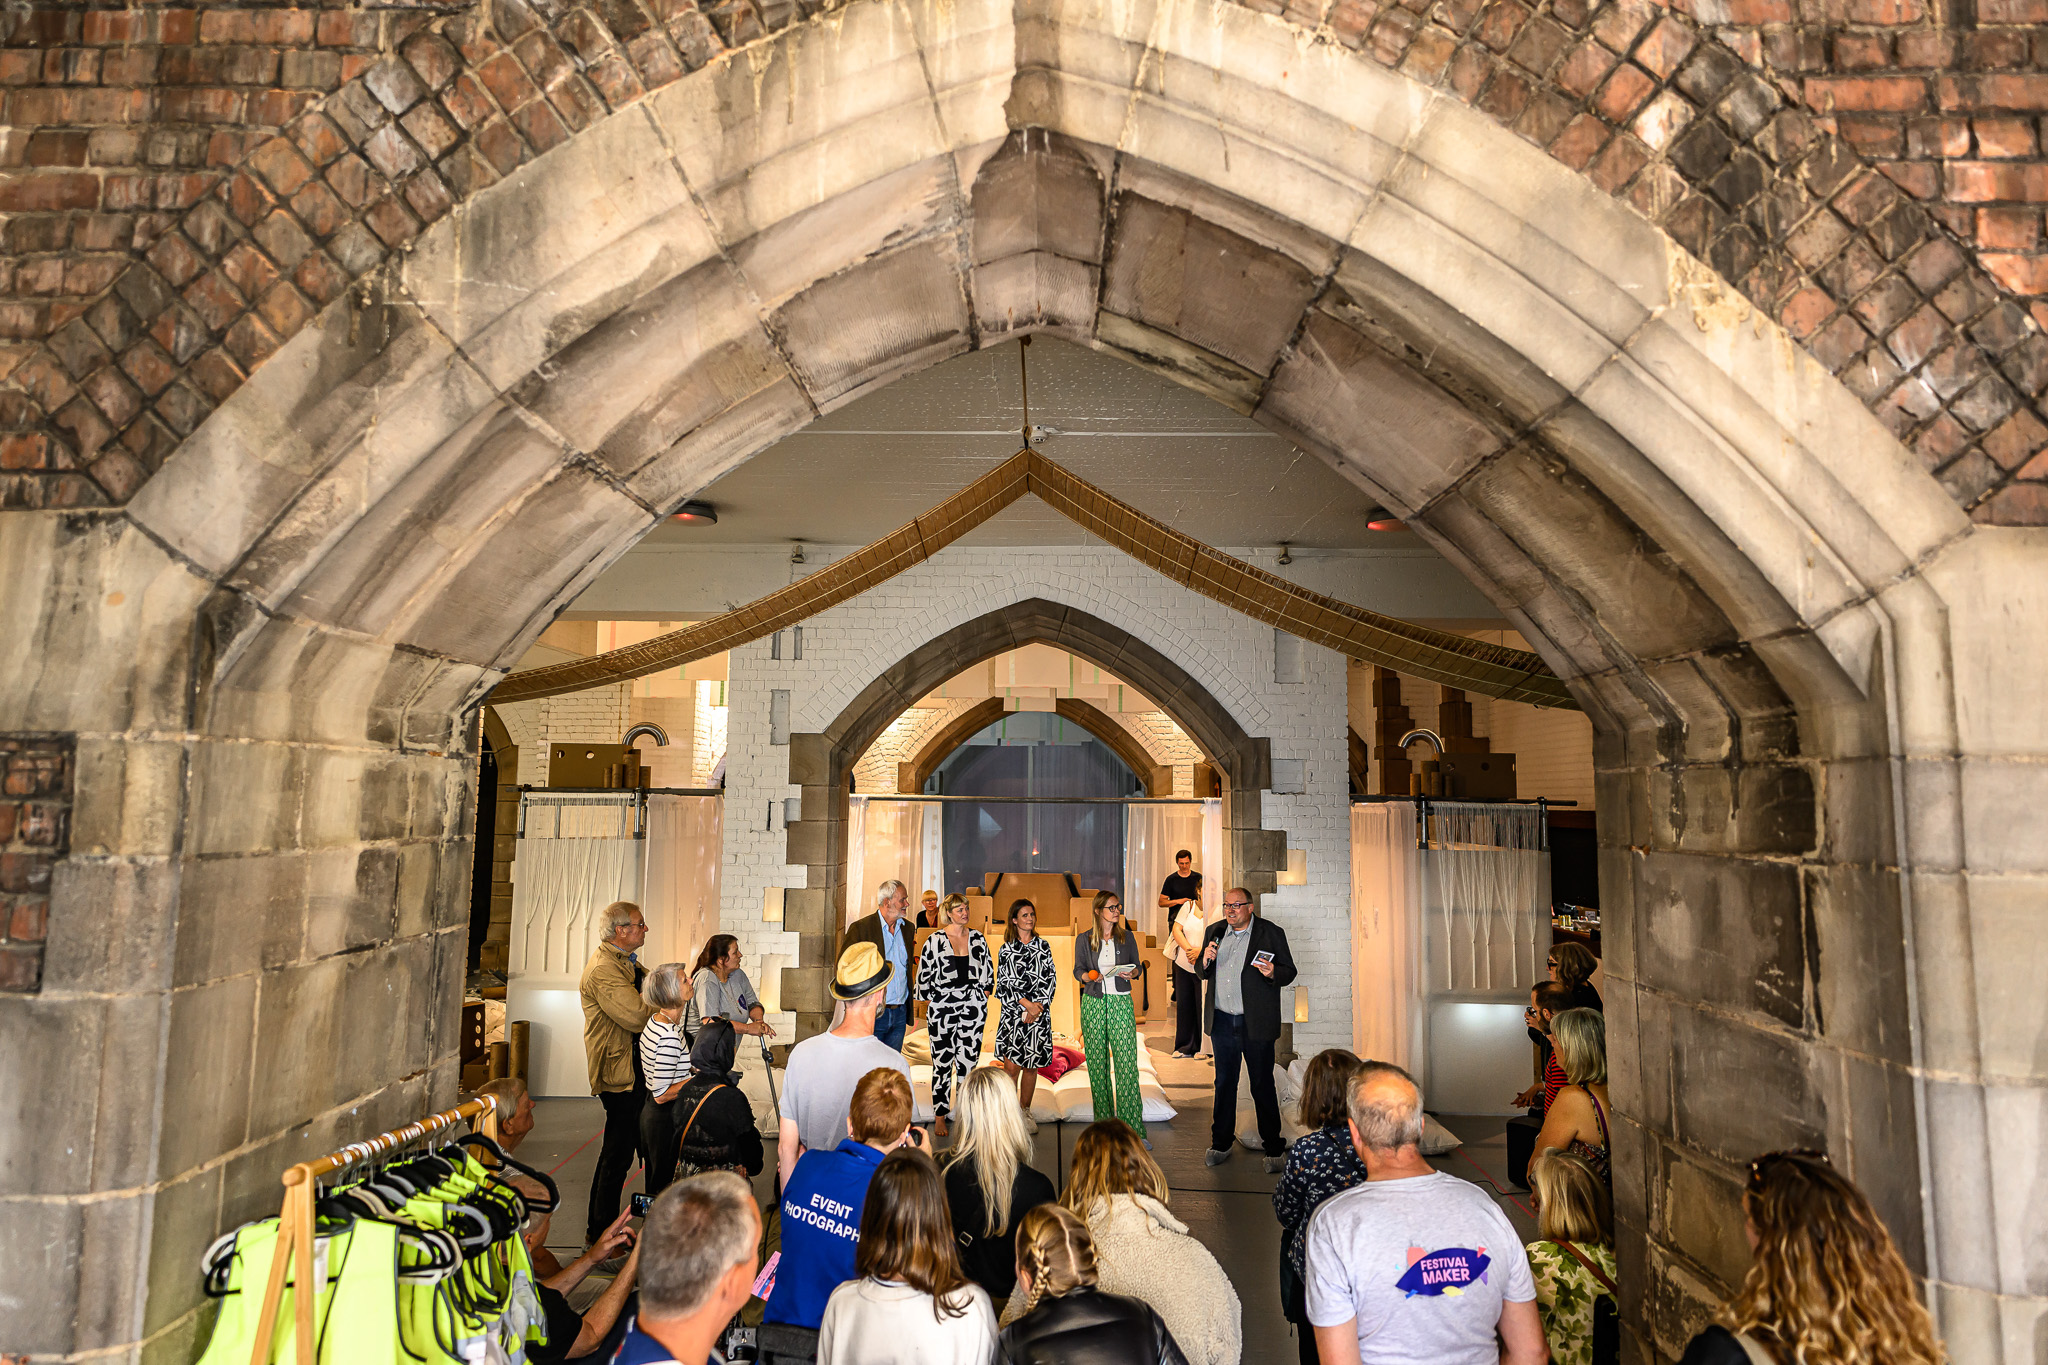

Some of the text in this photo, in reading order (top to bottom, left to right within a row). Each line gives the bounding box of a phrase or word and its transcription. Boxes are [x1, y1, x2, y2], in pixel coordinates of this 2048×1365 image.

[810, 1193, 853, 1219] EVENT
[1420, 1257, 1469, 1271] FESTIVAL
[1422, 1268, 1471, 1285] MAKER
